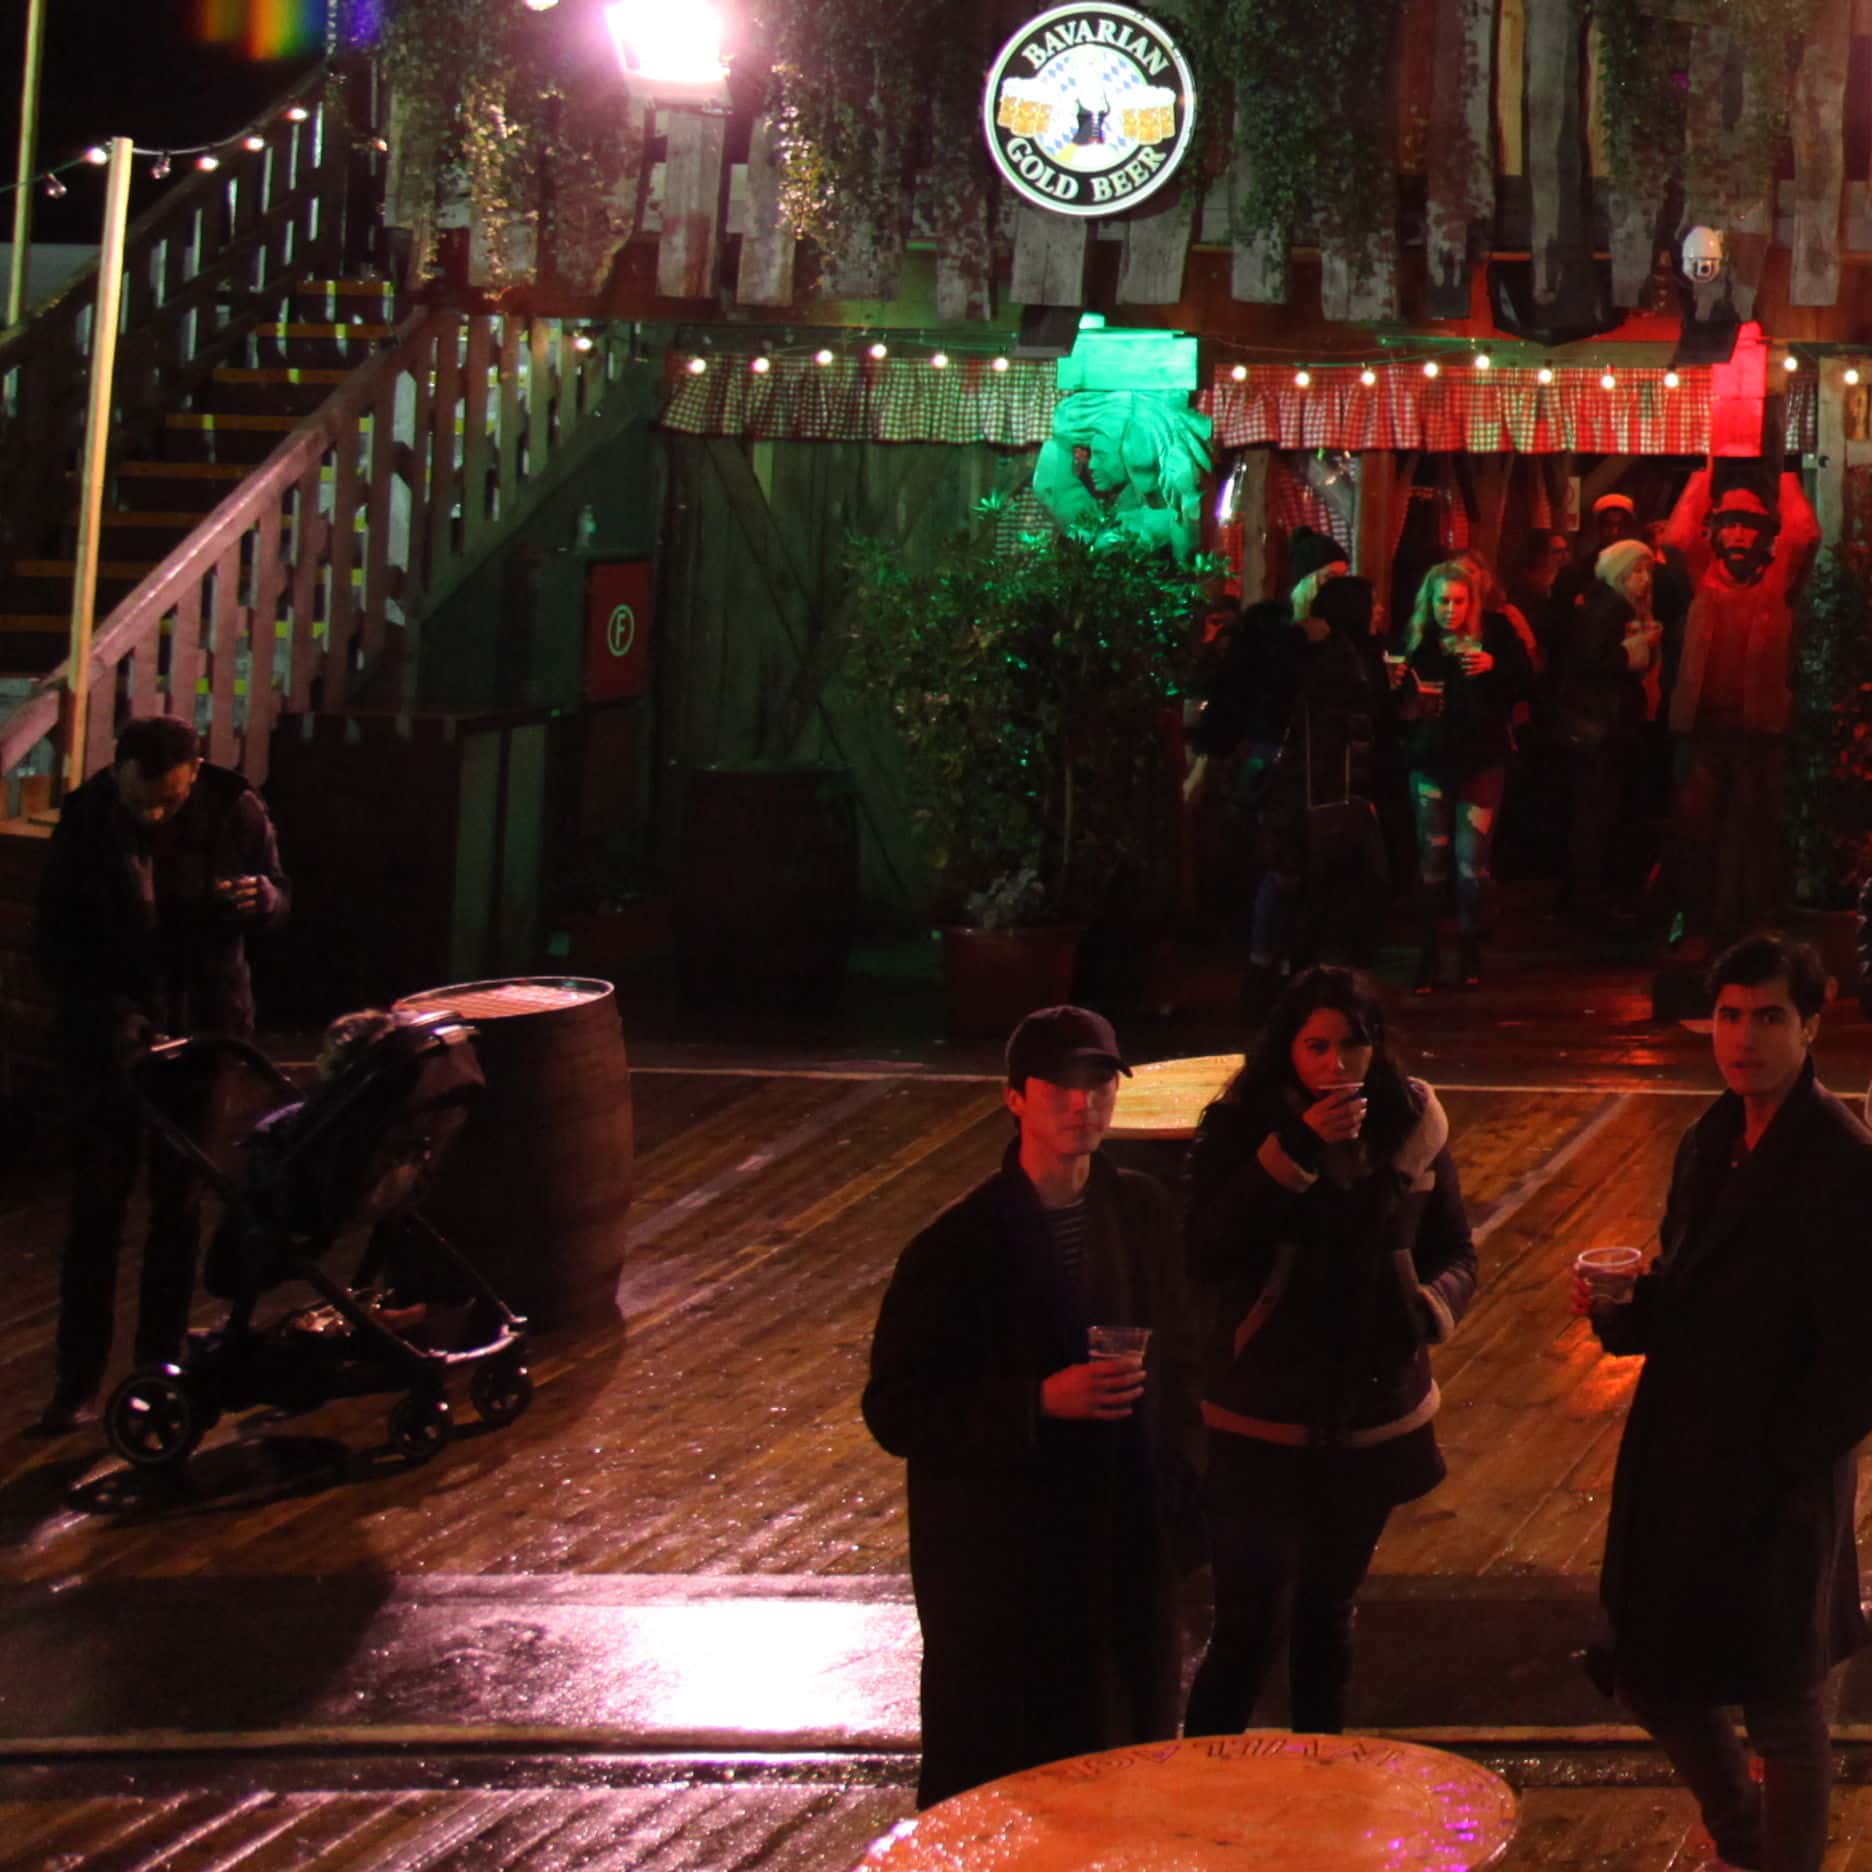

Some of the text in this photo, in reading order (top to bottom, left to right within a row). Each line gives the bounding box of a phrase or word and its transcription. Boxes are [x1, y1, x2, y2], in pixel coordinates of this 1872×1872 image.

[1021, 19, 1169, 76] BAVARIAN
[1006, 137, 1167, 201] GOLD BEER
